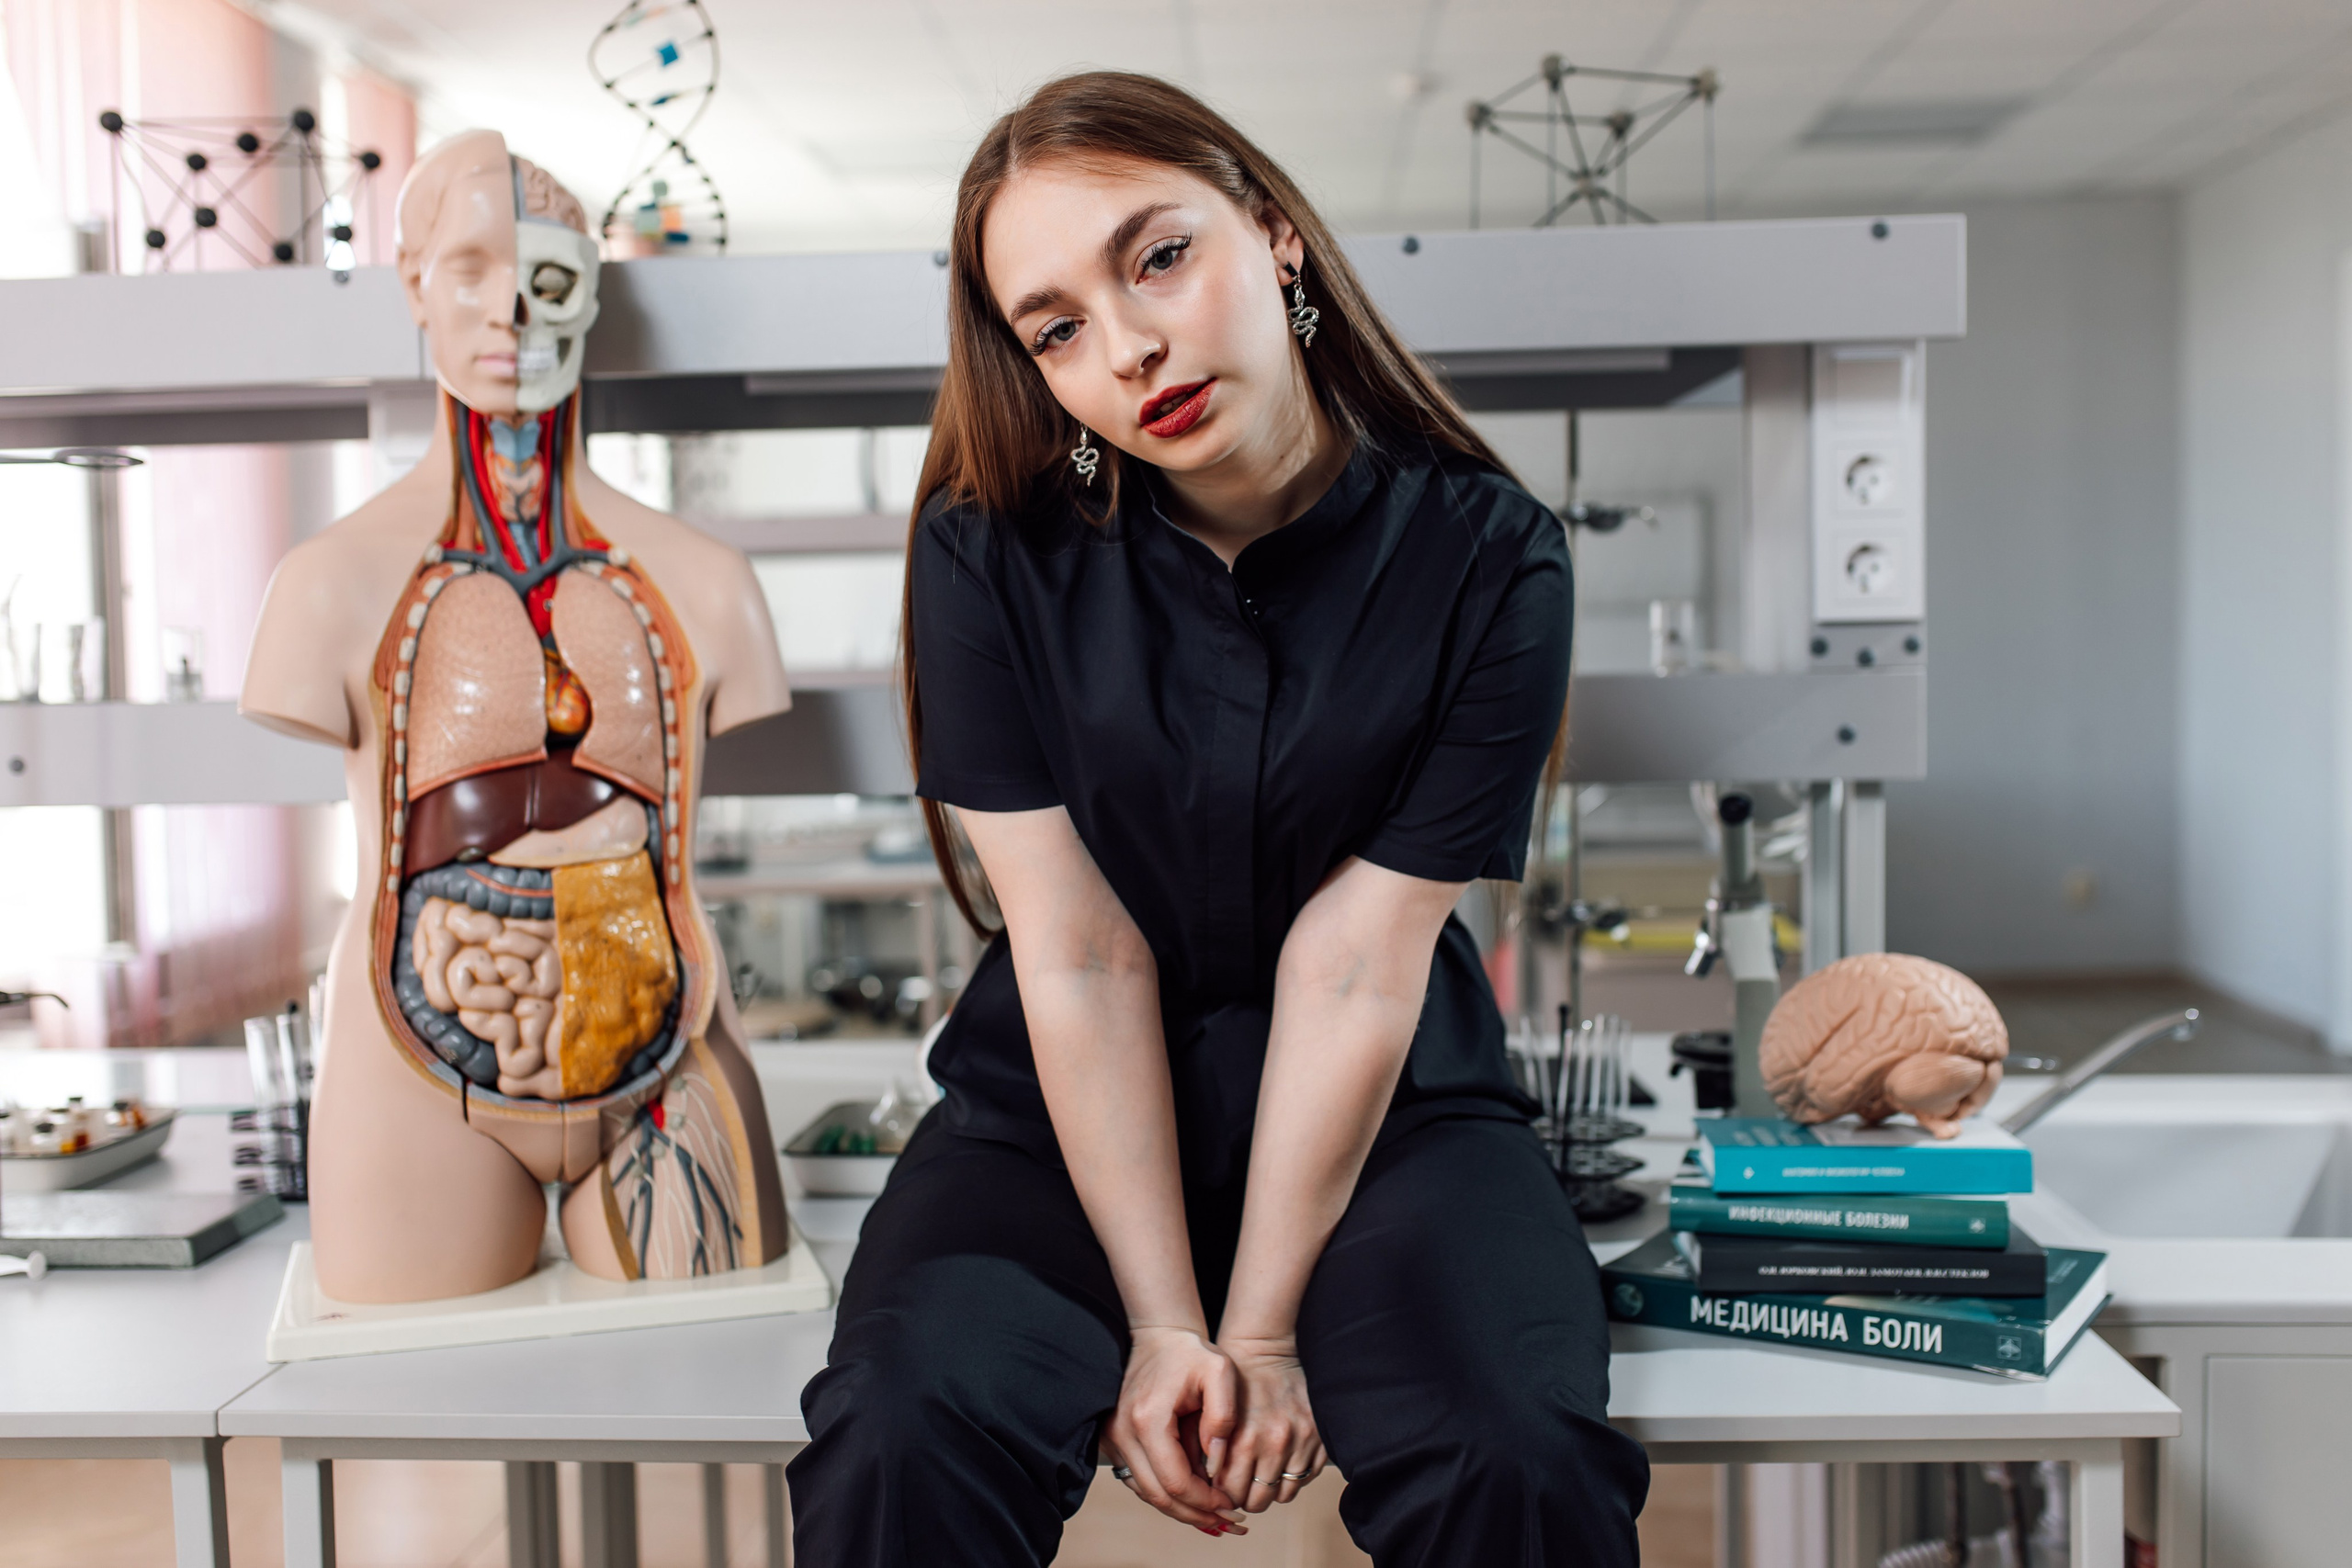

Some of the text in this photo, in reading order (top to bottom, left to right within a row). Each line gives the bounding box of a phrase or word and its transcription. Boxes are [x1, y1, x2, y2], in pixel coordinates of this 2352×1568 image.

[1728, 1205, 1909, 1230] ИНФЕКЦИОННЫЕ БОЛЕЗНИ
[1690, 1295, 1942, 1354] МЕДИЦИНА БОЛИ
